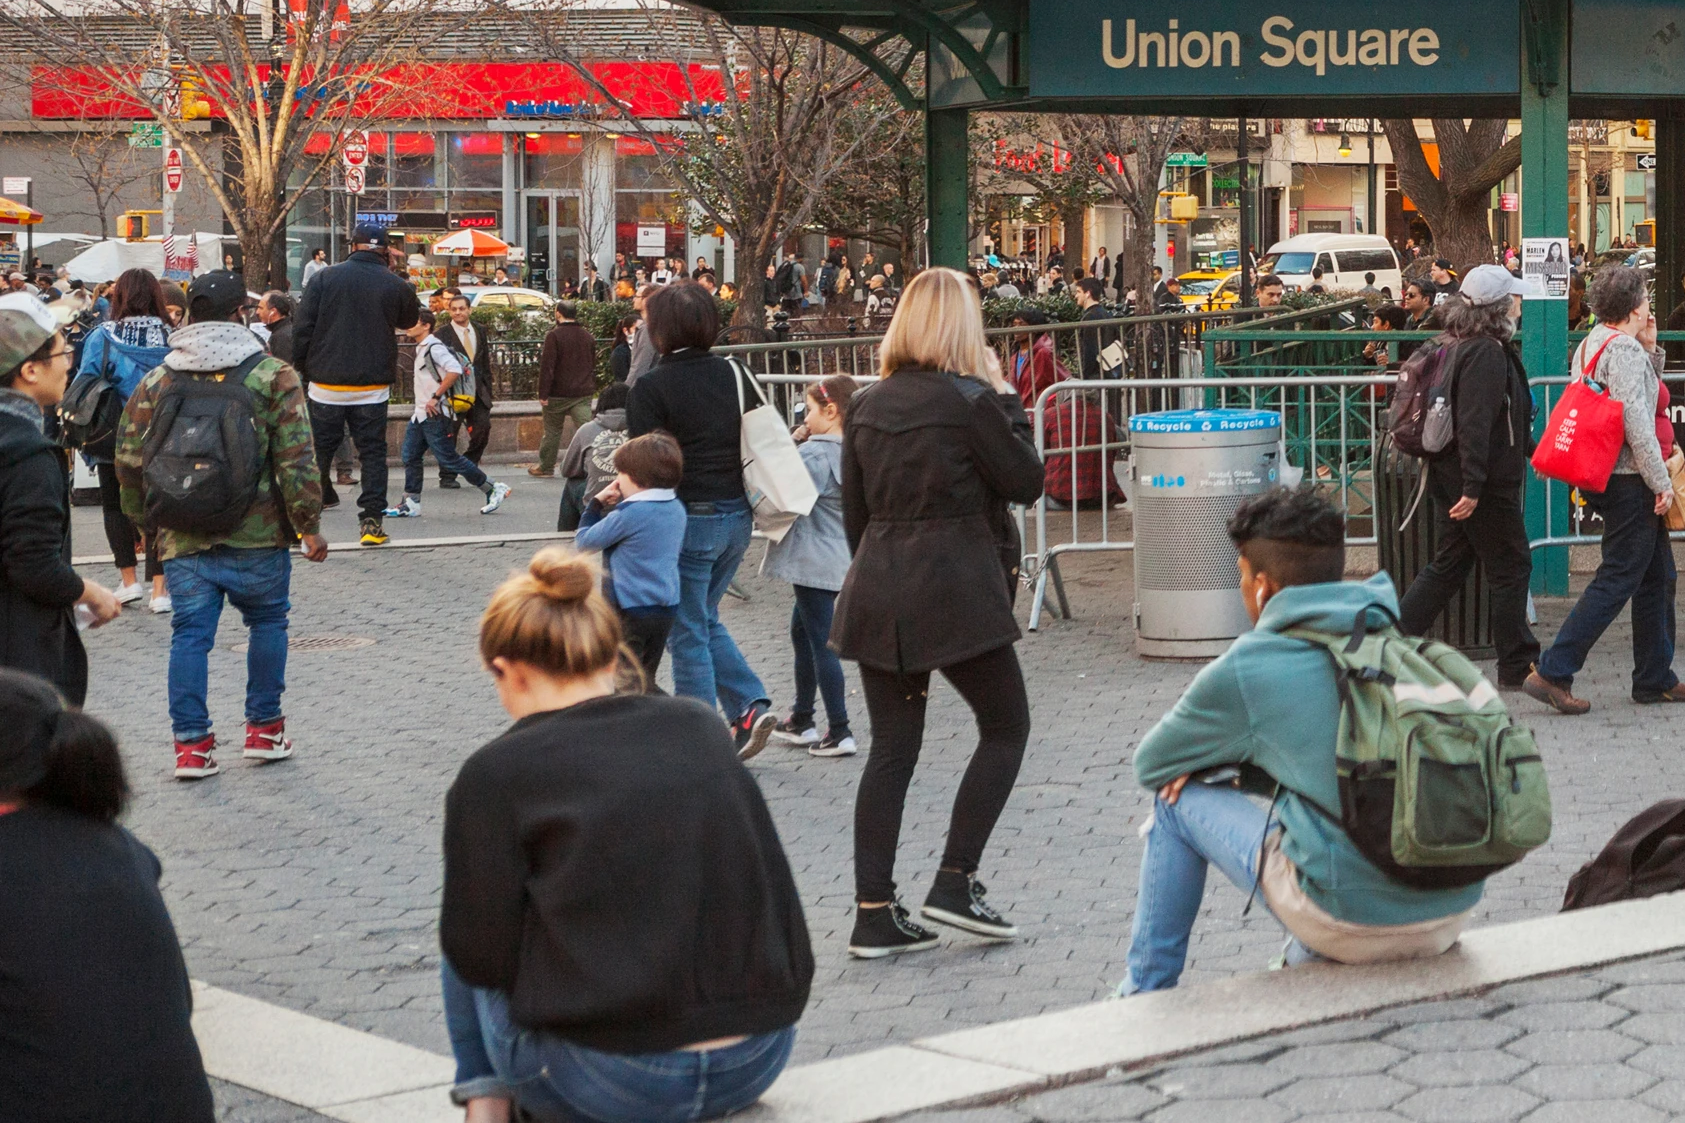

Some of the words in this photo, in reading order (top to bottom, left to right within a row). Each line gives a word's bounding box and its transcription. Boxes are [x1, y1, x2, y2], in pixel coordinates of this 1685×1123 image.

[1102, 18, 1241, 69] Union
[1259, 15, 1441, 76] Square
[1643, 158, 1655, 166] ONE
[1525, 261, 1567, 274] MISSING
[1146, 421, 1192, 433] Recycle
[1220, 418, 1265, 429] Recycle
[1563, 418, 1577, 426] KEEP
[1559, 425, 1576, 435] CALM
[1556, 434, 1574, 445] CARRY
